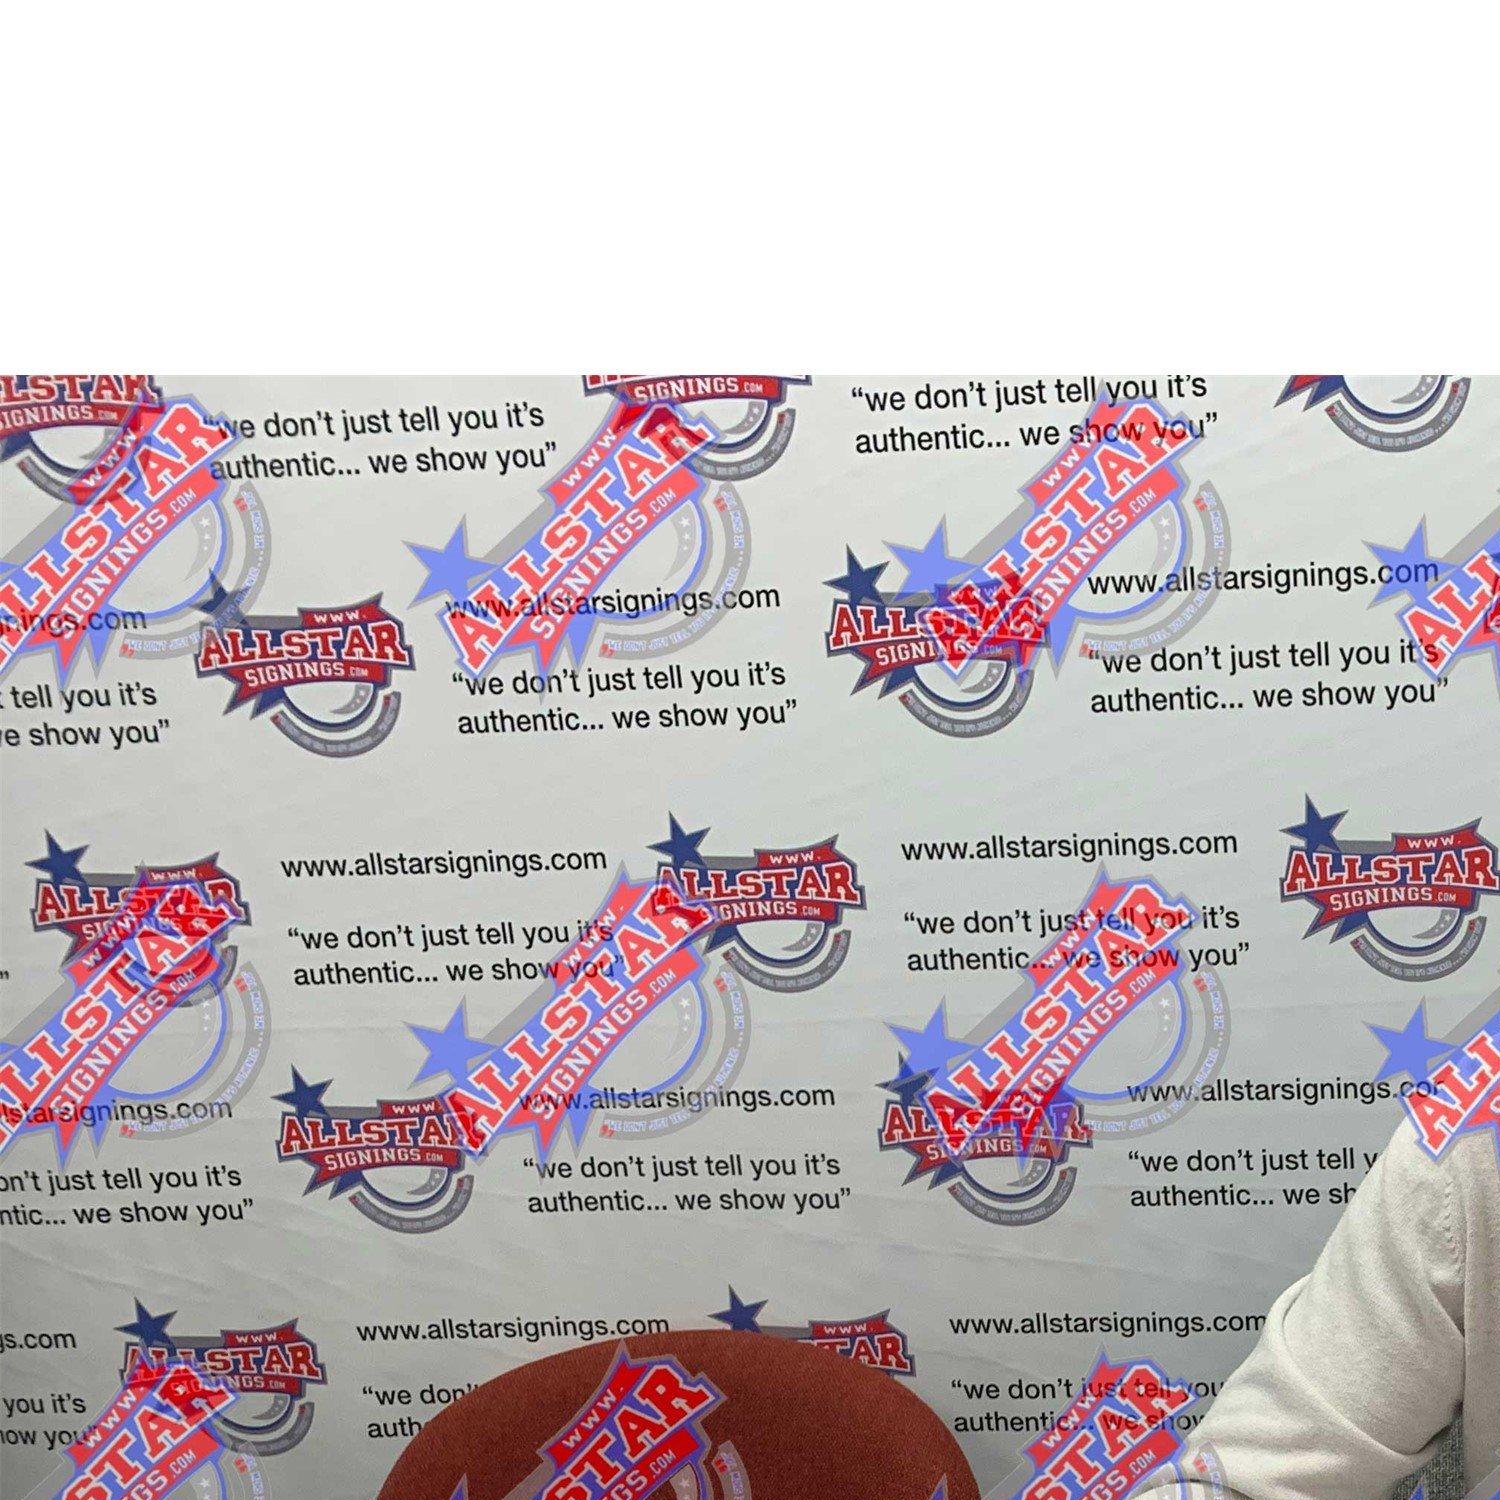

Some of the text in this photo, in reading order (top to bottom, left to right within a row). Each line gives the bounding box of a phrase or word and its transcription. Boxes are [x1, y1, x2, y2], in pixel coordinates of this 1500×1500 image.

[852, 375, 1208, 413] “we don’t just tell you it’s
[264, 411, 335, 437] don’t
[342, 409, 392, 441] just
[398, 406, 439, 432] tell
[448, 410, 498, 437] you
[506, 402, 544, 427] it’s
[856, 423, 1009, 453] authentic...
[1019, 424, 1061, 446] we
[1069, 417, 1144, 444] show
[213, 441, 556, 480] authentic... we show you”
[1087, 560, 1440, 596] www.allstarsignings.com
[198, 620, 411, 671] ALLSTAR
[1089, 637, 1439, 676] “we don’t just tell you it’s
[453, 662, 785, 698] “we don’t just tell you it’s
[1091, 677, 1448, 713] authentic... we show you”
[458, 699, 796, 734] authentic... we show you”
[281, 848, 609, 880] www.allstarsignings.com
[901, 832, 1237, 863] www.allstarsignings.com
[1284, 845, 1500, 896] ALLSTAR
[288, 917, 614, 952] “we don’t just tell you it’s
[294, 960, 438, 986] authentic...
[446, 964, 483, 981] we
[488, 956, 558, 982] show
[519, 1084, 836, 1115] www.allstarsignings.com
[524, 1154, 840, 1182] “we don’t just tell you it’s
[528, 1186, 851, 1216] authentic... we show you”
[356, 1316, 669, 1346] www.allstarsignings.com
[949, 1310, 1267, 1340] www.allstarsignings.com
